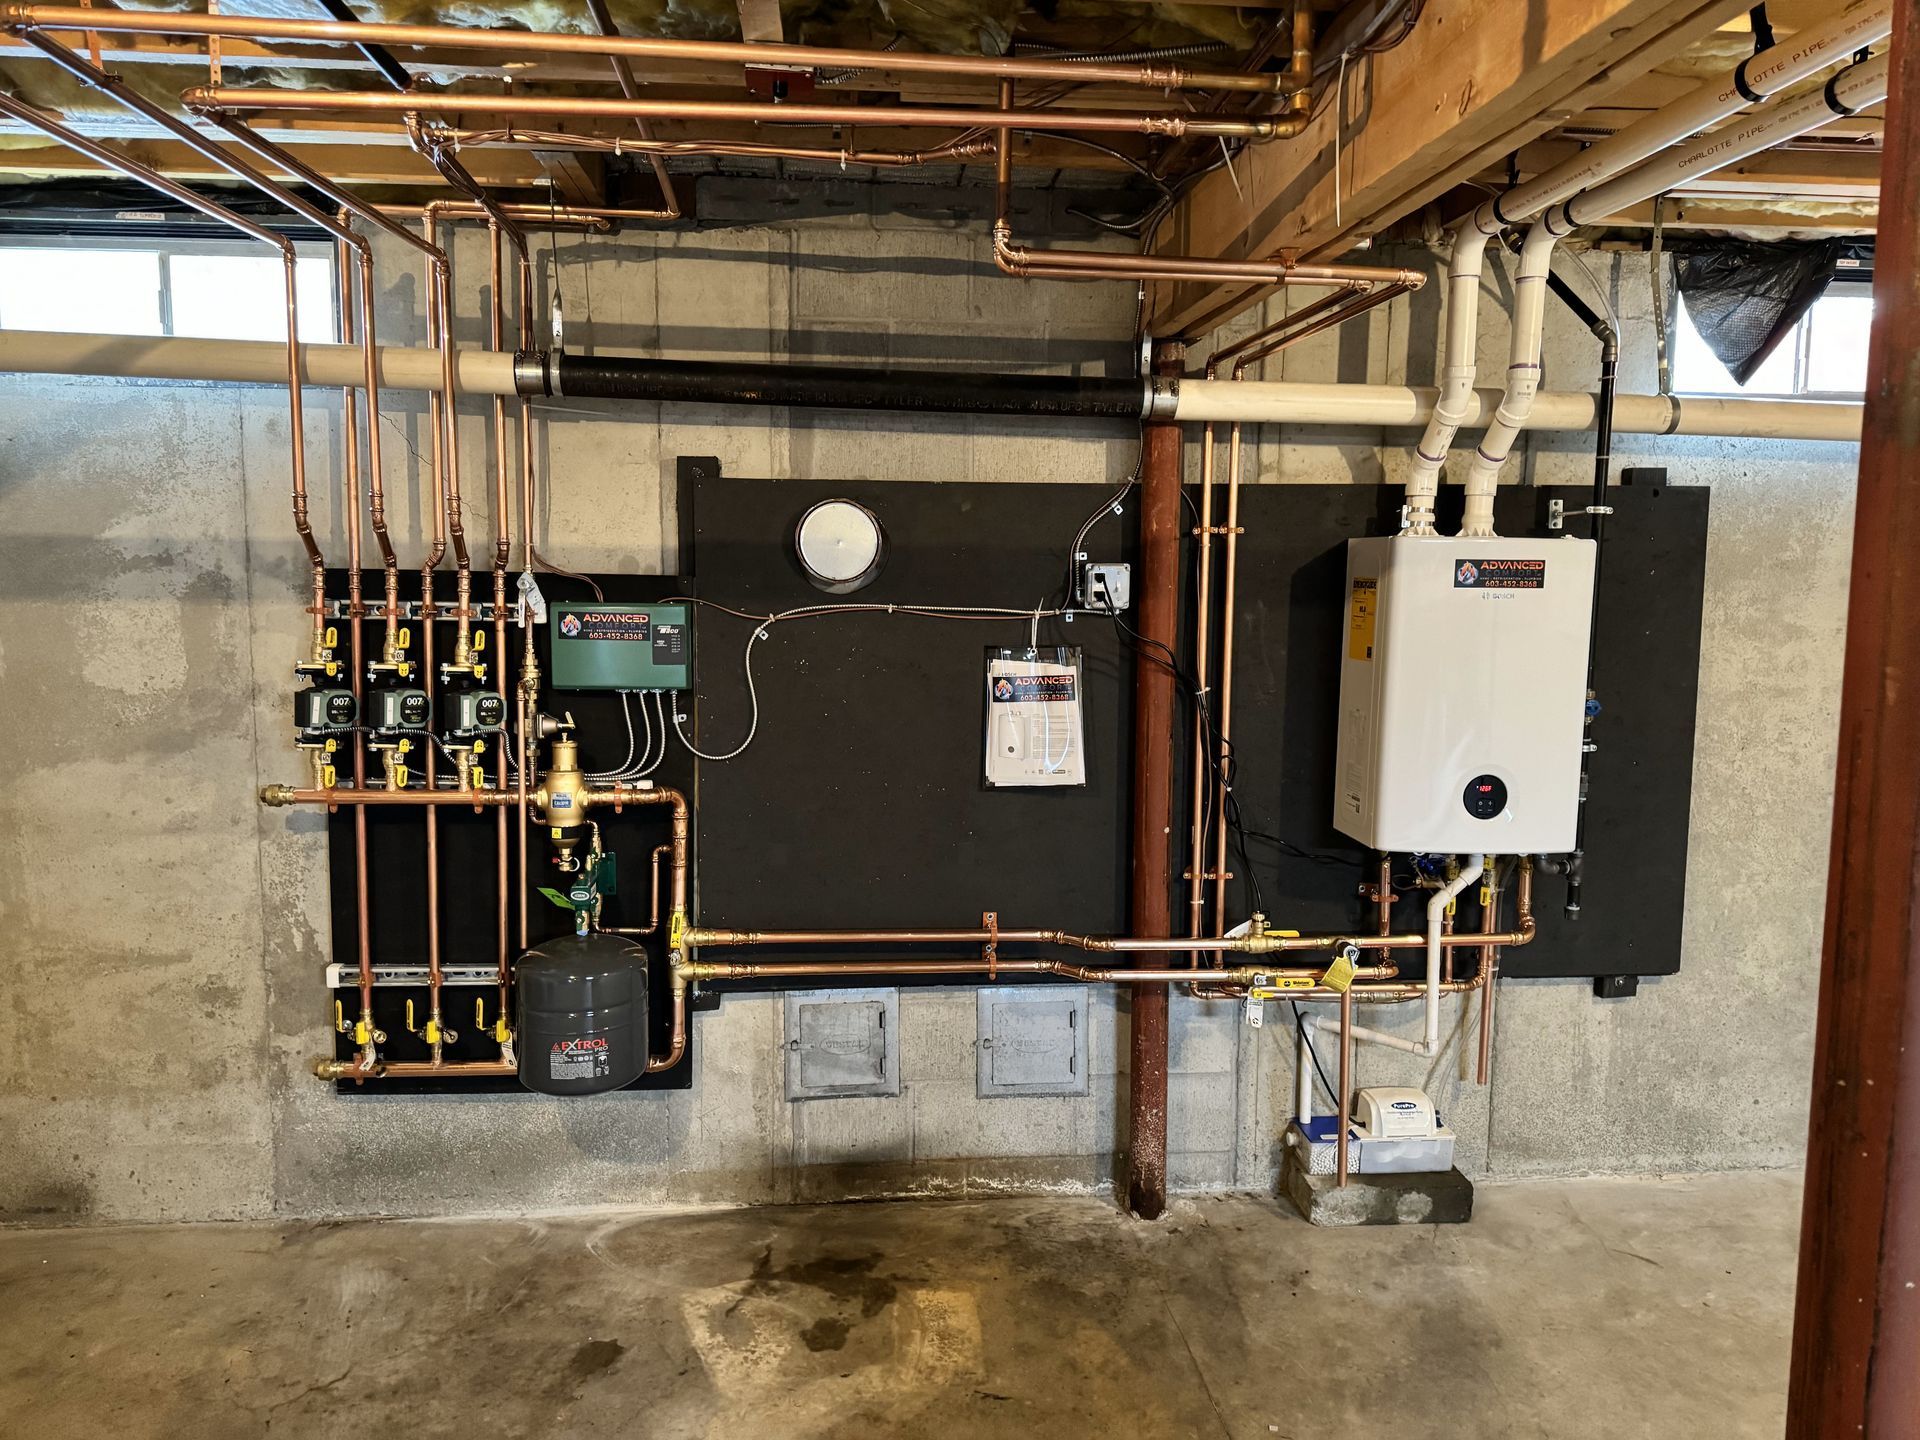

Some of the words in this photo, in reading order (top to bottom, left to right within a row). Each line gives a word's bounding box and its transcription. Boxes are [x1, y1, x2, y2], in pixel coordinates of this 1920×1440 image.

[1718, 61, 1786, 102] CHALOTTE
[1792, 38, 1827, 63] PIPE
[1678, 139, 1732, 168] CHARLOTTE
[1737, 125, 1765, 143] PIPE
[1480, 561, 1544, 570] ADVANCED
[583, 613, 649, 623] ADVANCED
[588, 632, 643, 640] 603-452-8368
[1015, 676, 1073, 685] ADVANCED
[561, 1038, 609, 1054] EXTROL
